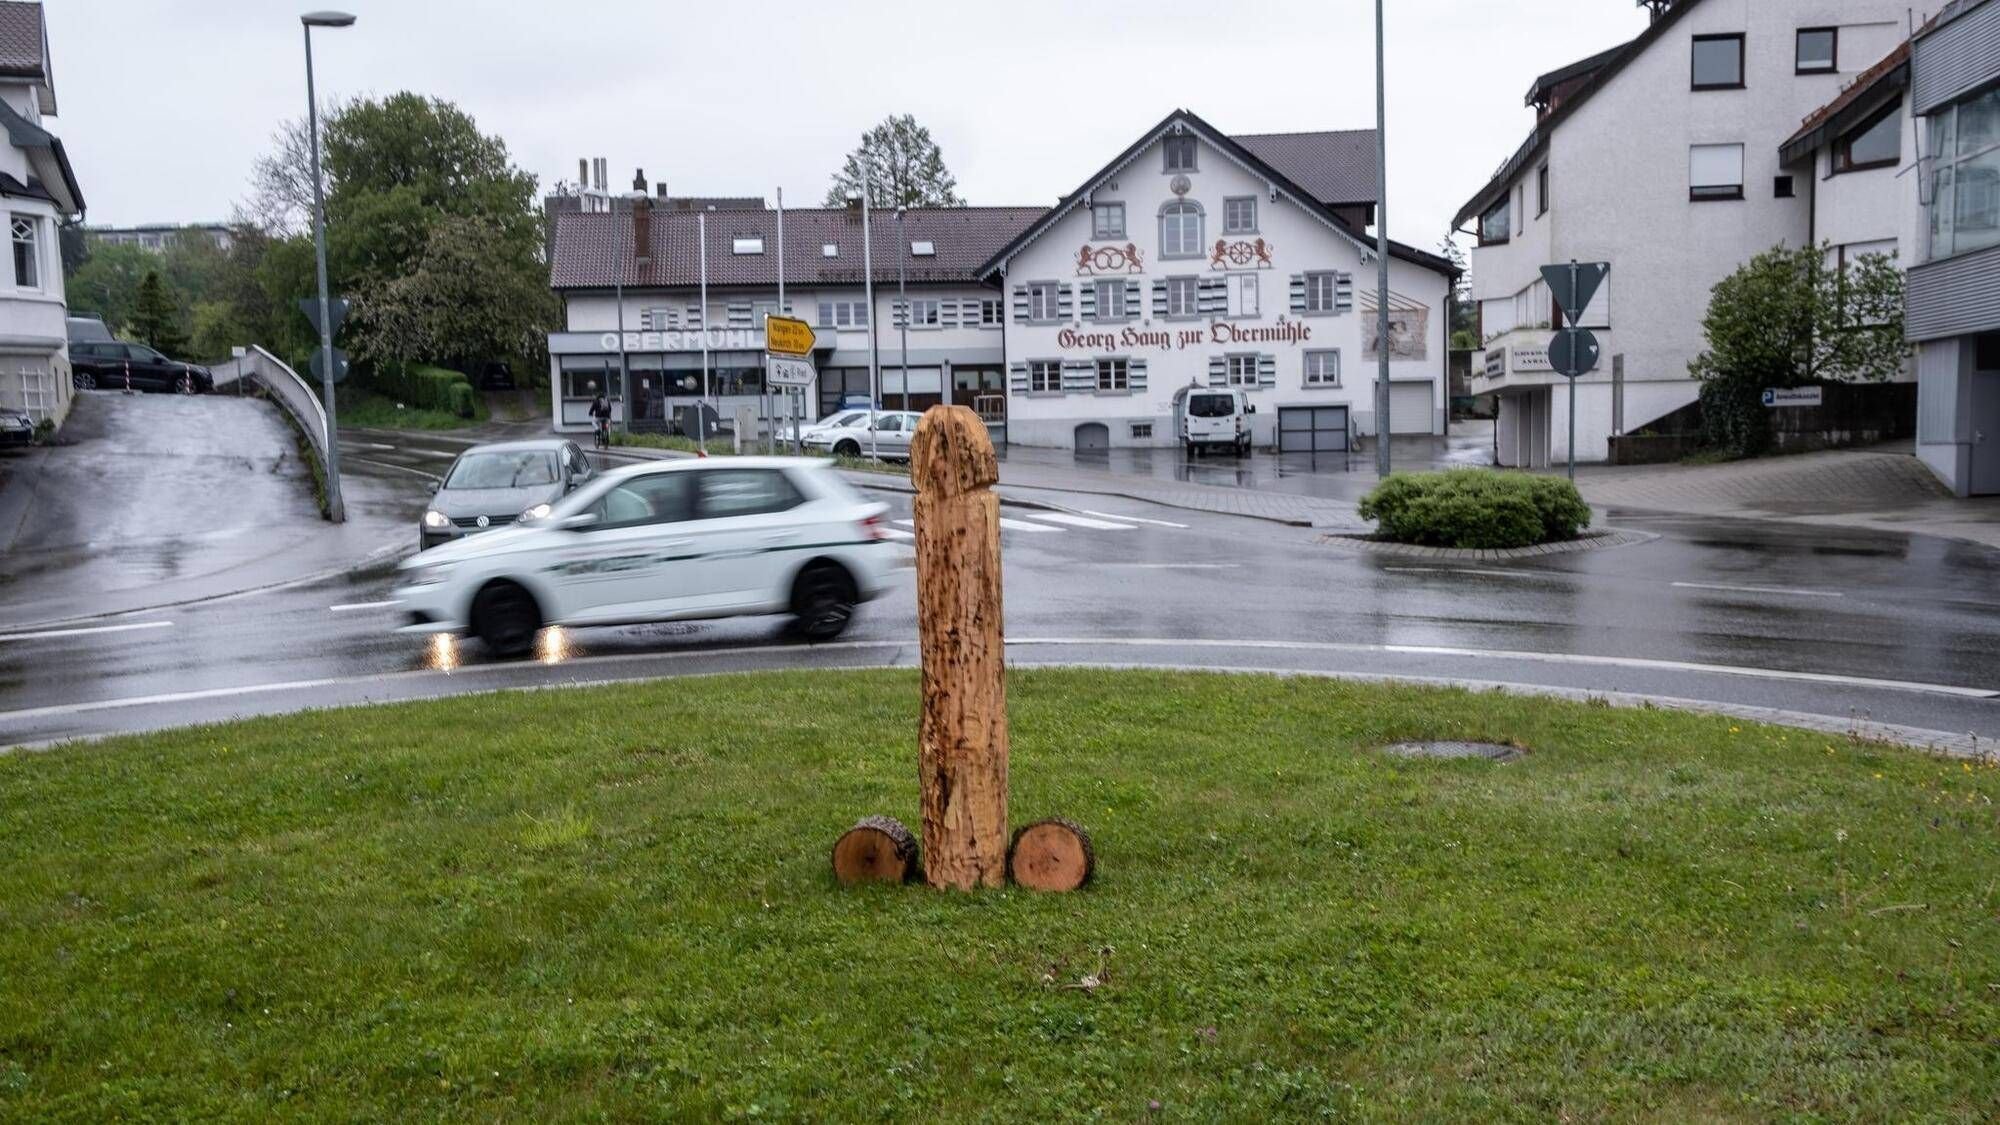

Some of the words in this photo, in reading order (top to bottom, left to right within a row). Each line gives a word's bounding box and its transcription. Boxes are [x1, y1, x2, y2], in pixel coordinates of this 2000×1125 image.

[601, 330, 765, 351] OBERMÜHL
[1058, 327, 1116, 352] Georg
[1120, 326, 1171, 350] Haug
[1176, 330, 1203, 350] zur
[1211, 320, 1311, 345] Obermühle
